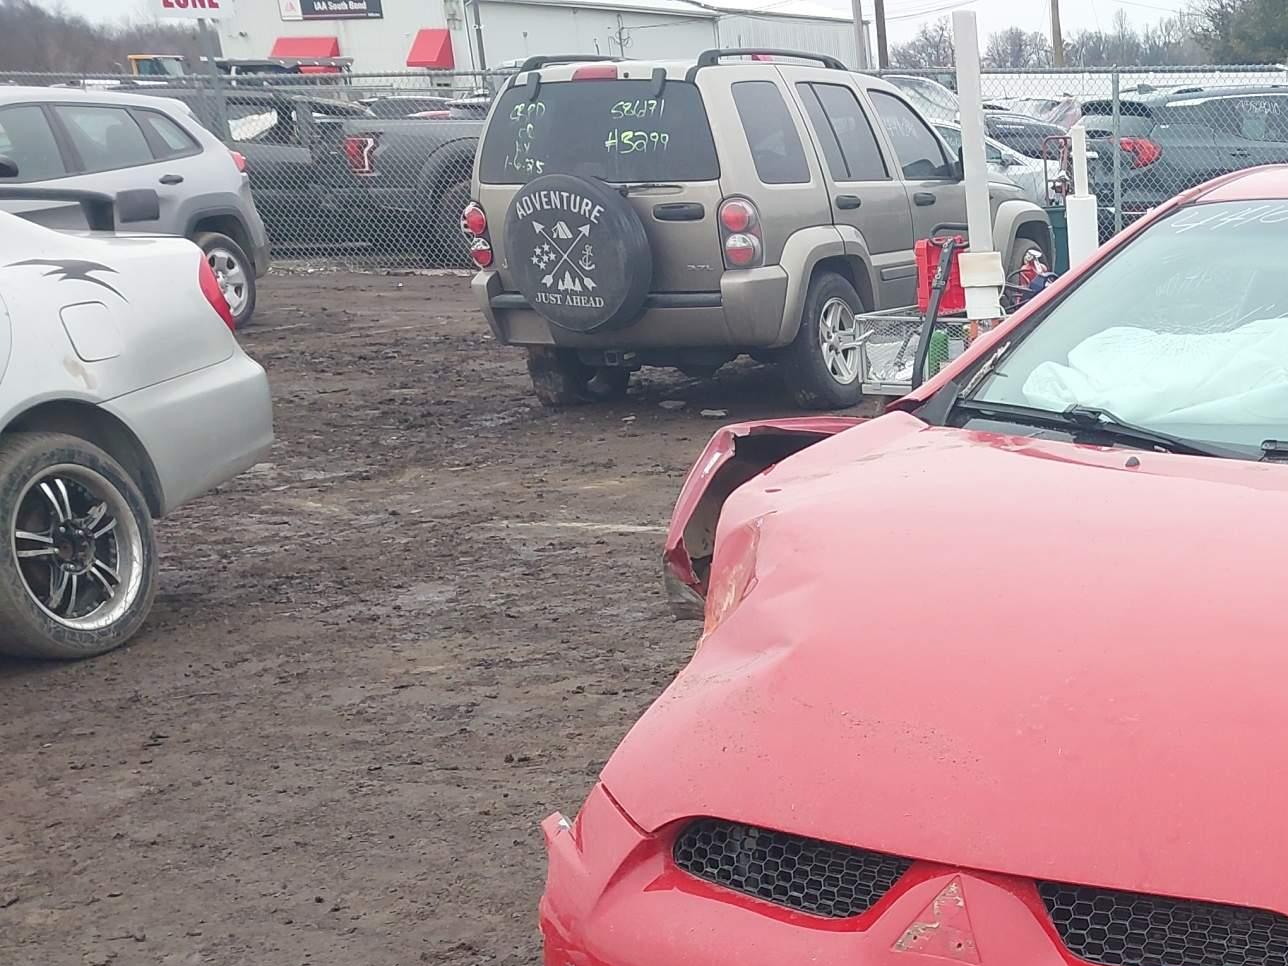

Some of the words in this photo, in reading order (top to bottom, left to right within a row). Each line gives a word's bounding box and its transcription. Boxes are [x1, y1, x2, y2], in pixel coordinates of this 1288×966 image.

[313, 1, 328, 11] IAA
[328, 1, 348, 11] South
[348, 0, 368, 10] Bend
[516, 190, 605, 224] ADVENTURE
[535, 292, 562, 305] JUST
[565, 294, 605, 308] AHEAD
